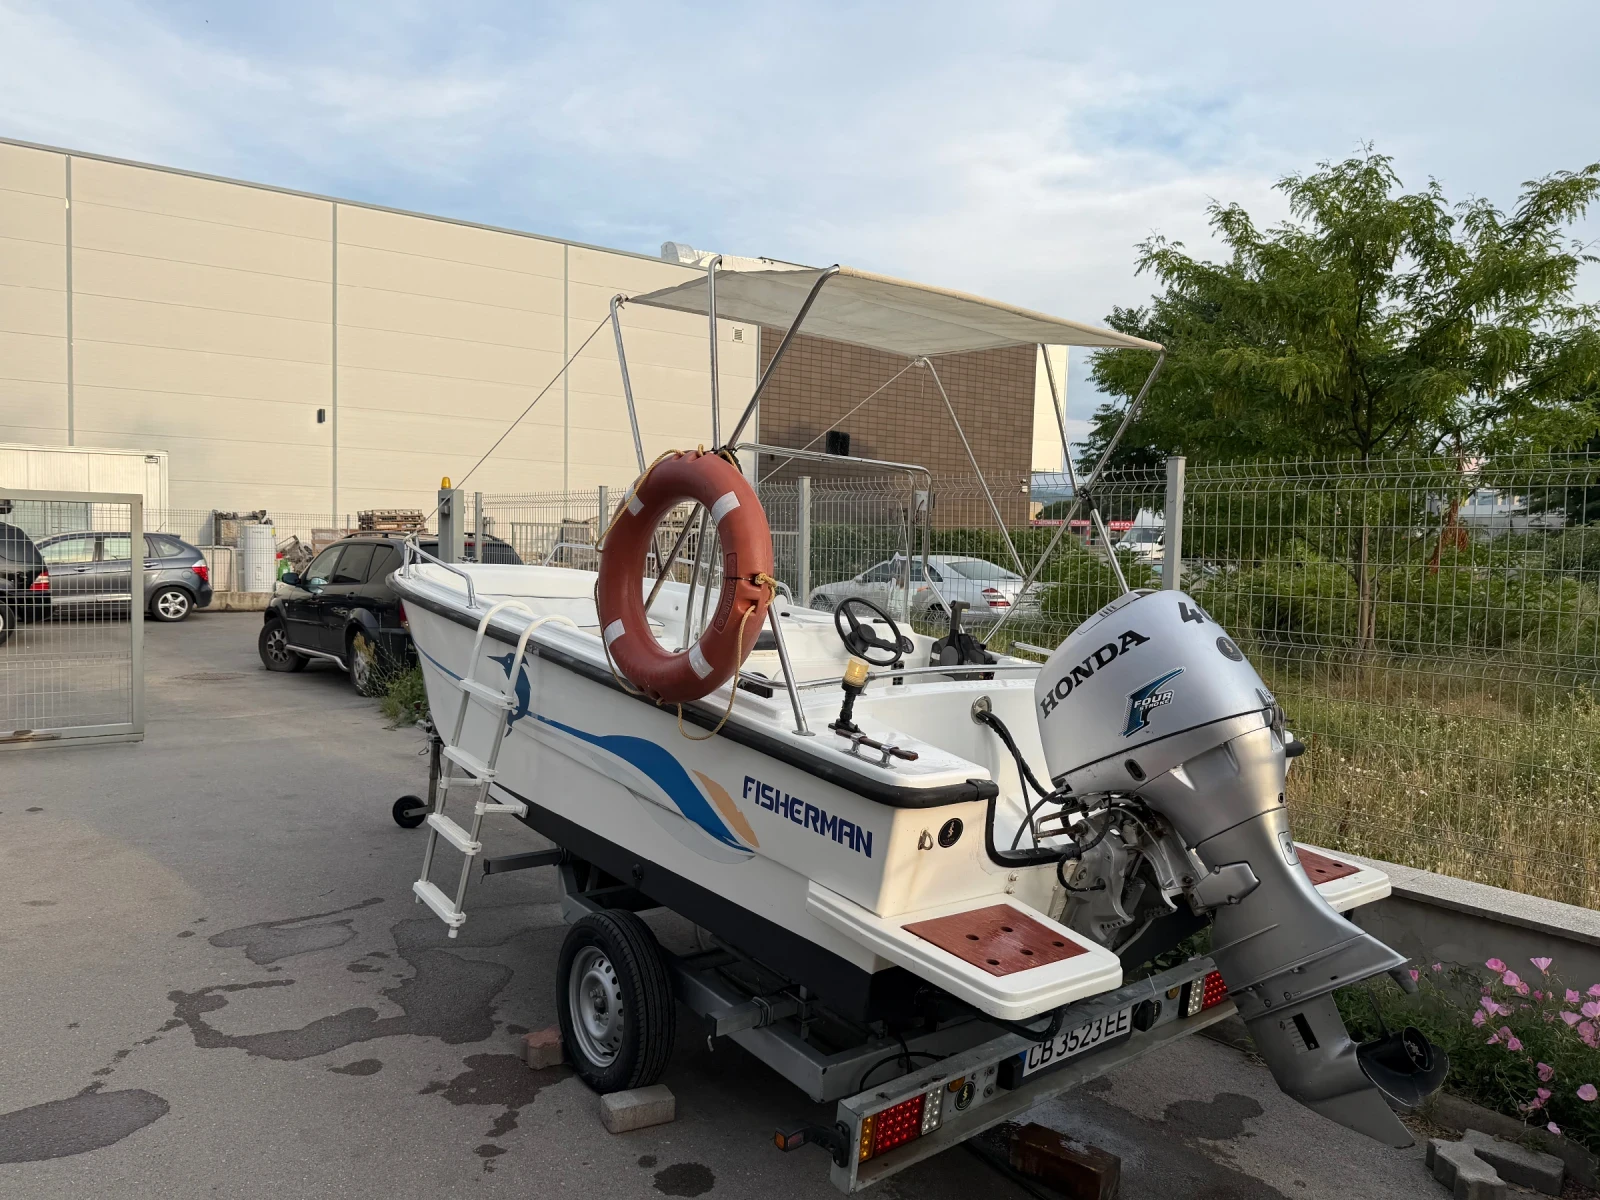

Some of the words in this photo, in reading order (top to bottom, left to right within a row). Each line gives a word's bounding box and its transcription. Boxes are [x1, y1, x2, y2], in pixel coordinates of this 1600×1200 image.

[1040, 630, 1150, 719] HONDA
[1134, 692, 1172, 708] FOUR
[1139, 700, 1170, 710] STROKE
[743, 775, 873, 858] FISHERMAN
[1028, 1038, 1054, 1069] CB
[1056, 1018, 1102, 1057] 3523
[1105, 1011, 1127, 1037] EE
